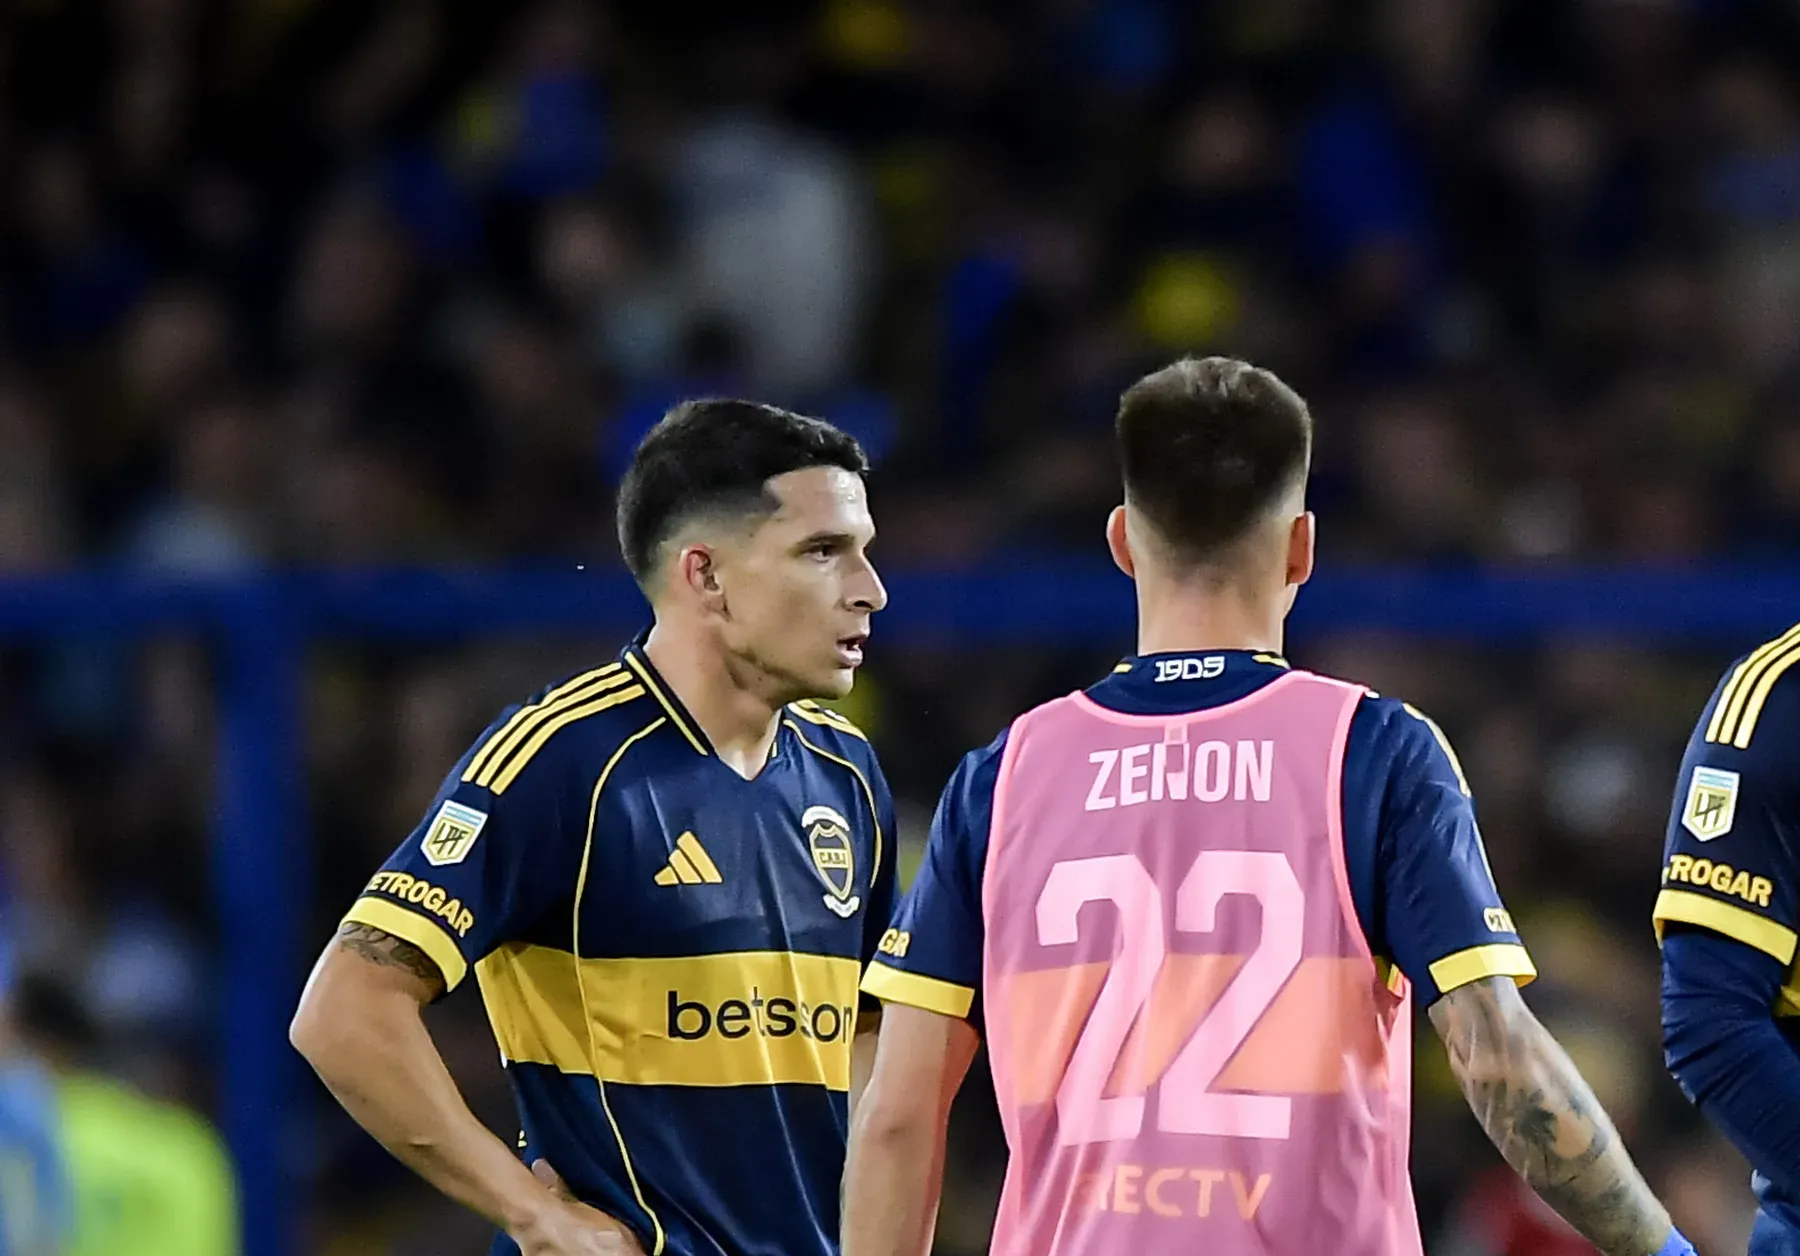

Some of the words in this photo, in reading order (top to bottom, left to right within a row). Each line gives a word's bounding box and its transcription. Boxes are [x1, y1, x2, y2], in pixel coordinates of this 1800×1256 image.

[1154, 656, 1225, 682] 1905
[1085, 740, 1274, 811] ZENON
[1035, 850, 1305, 1147] 22
